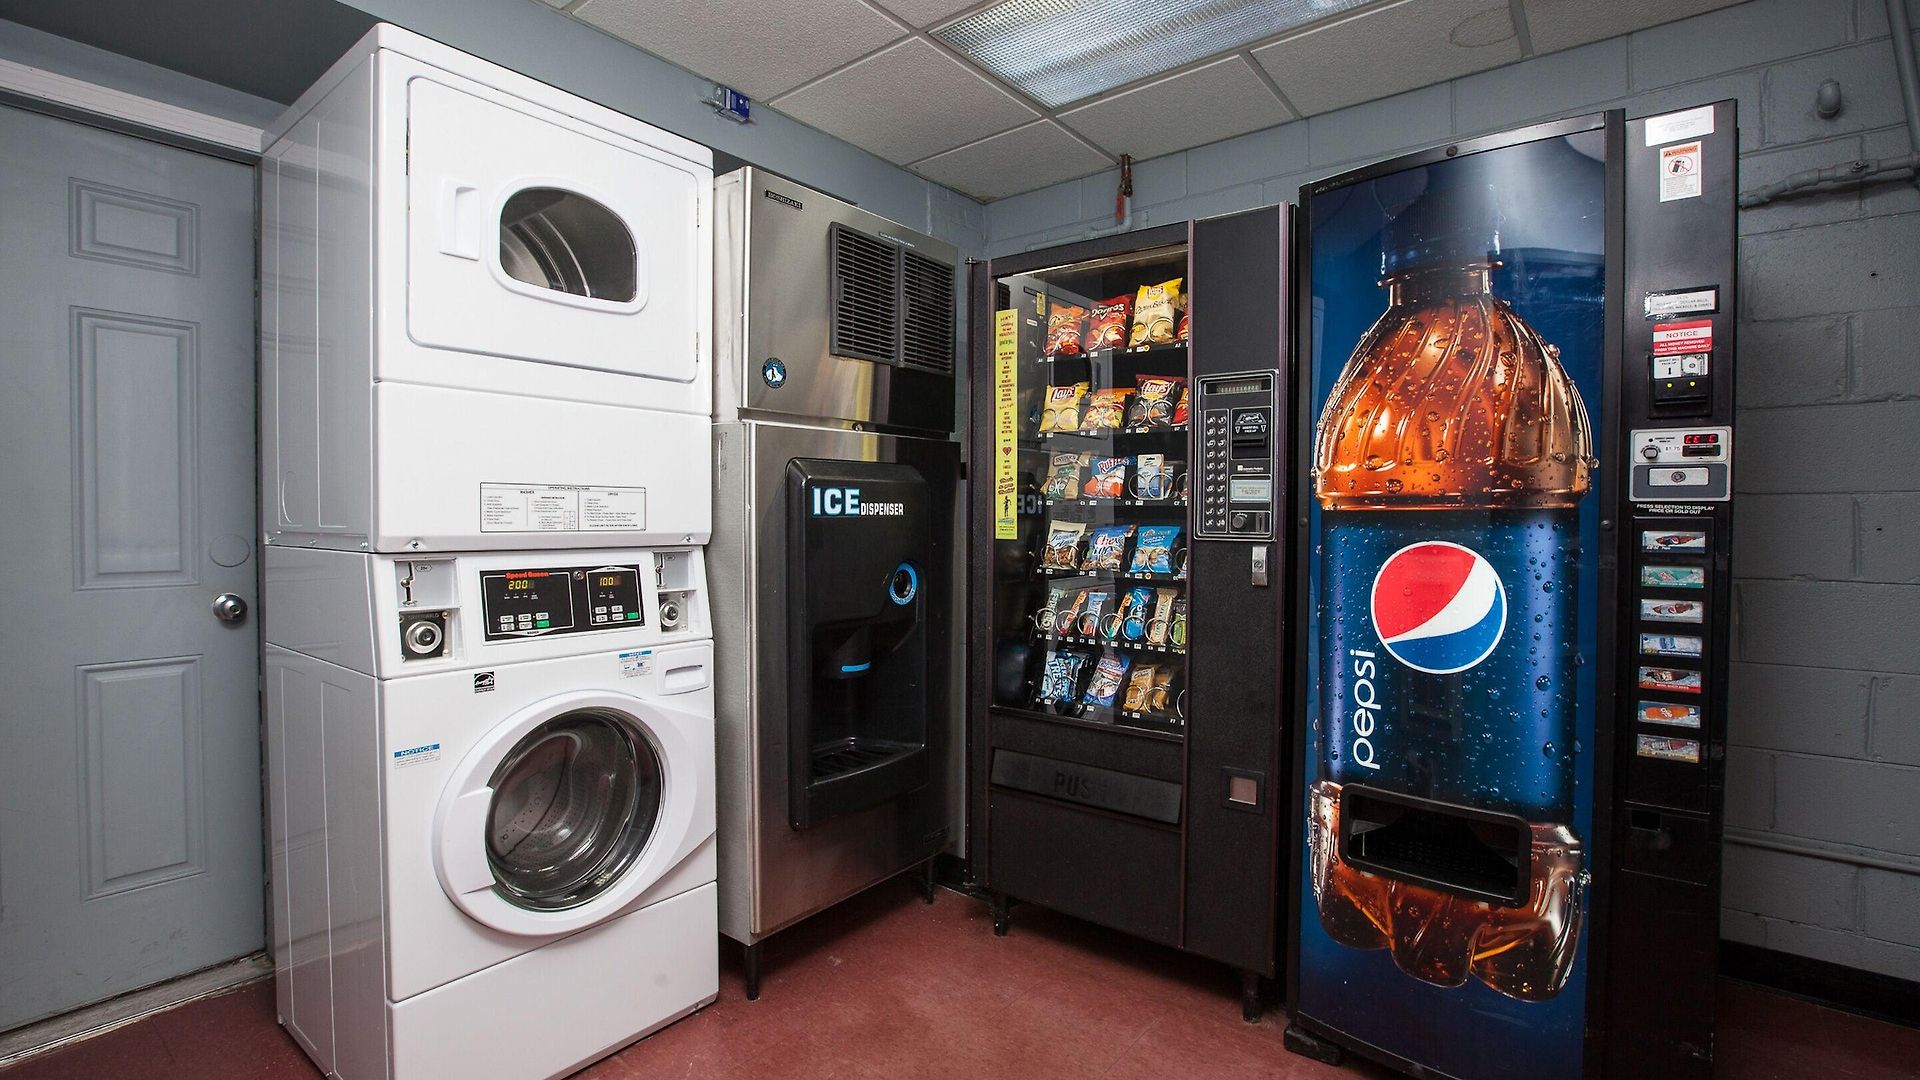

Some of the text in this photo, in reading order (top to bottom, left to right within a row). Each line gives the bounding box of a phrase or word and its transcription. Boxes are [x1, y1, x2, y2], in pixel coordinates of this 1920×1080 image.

[1666, 330, 1699, 339] NOTICE
[813, 488, 904, 516] ICE DISPENSER
[1095, 533, 1124, 546] Chex
[508, 580, 528, 590] 200
[600, 576, 614, 586] 100
[1047, 660, 1061, 697] TREATS
[1350, 648, 1381, 770] pepsi
